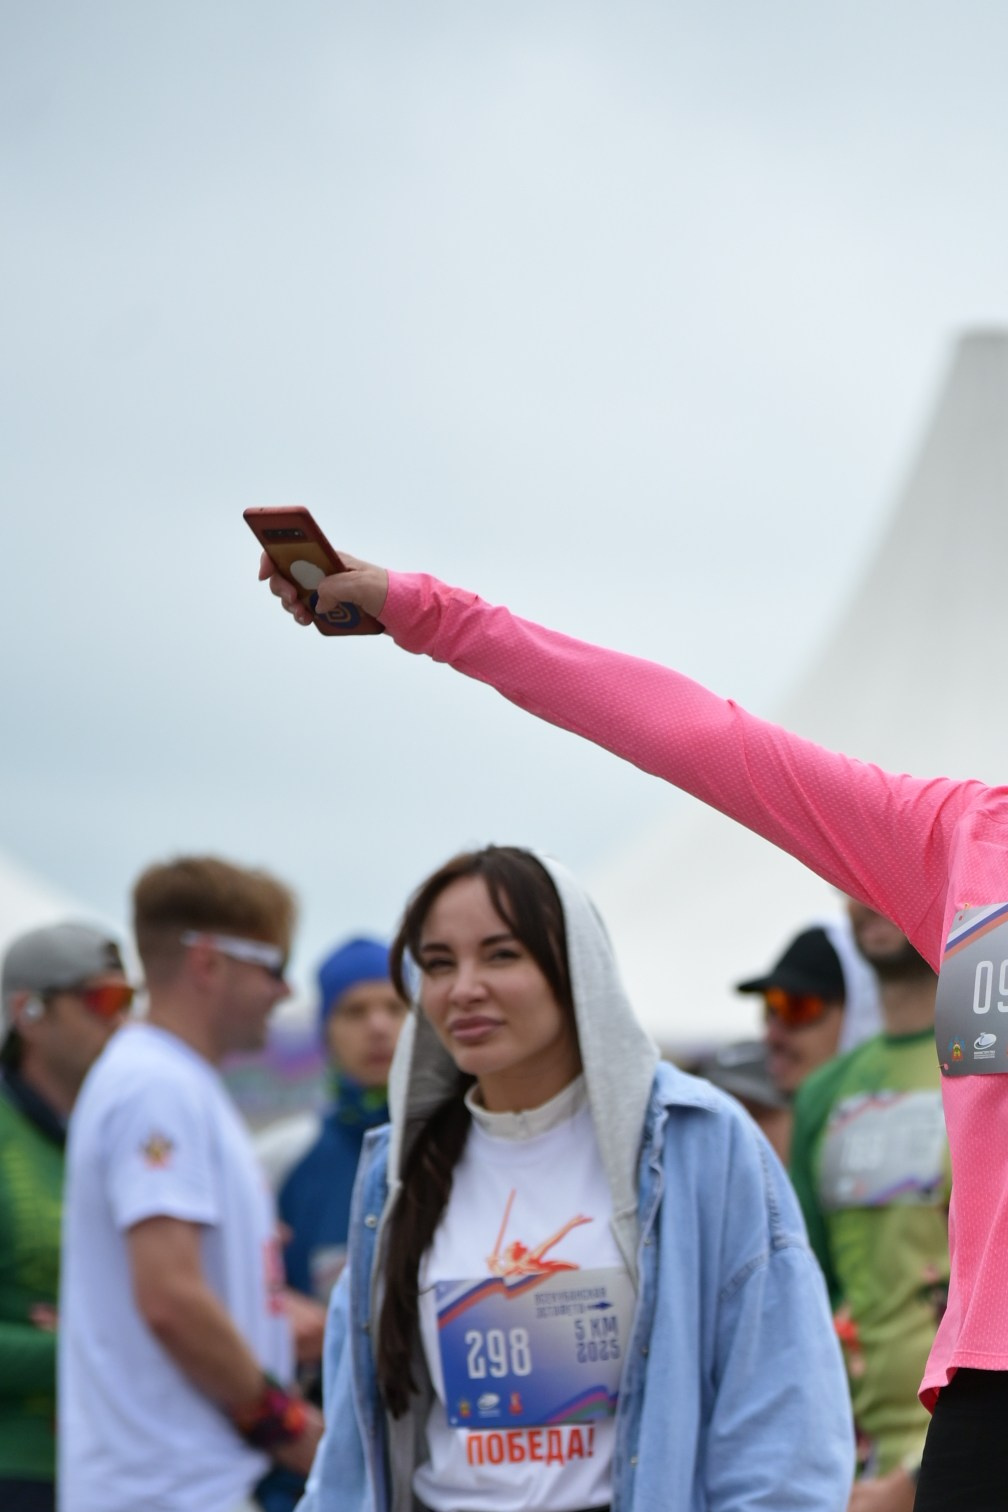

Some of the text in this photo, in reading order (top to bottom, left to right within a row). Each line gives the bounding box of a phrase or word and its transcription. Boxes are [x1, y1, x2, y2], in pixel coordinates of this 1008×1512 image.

[575, 1319, 586, 1341] 5
[464, 1327, 533, 1380] 298
[577, 1339, 621, 1363] 2025
[466, 1427, 596, 1467] ПОБЕДА!
